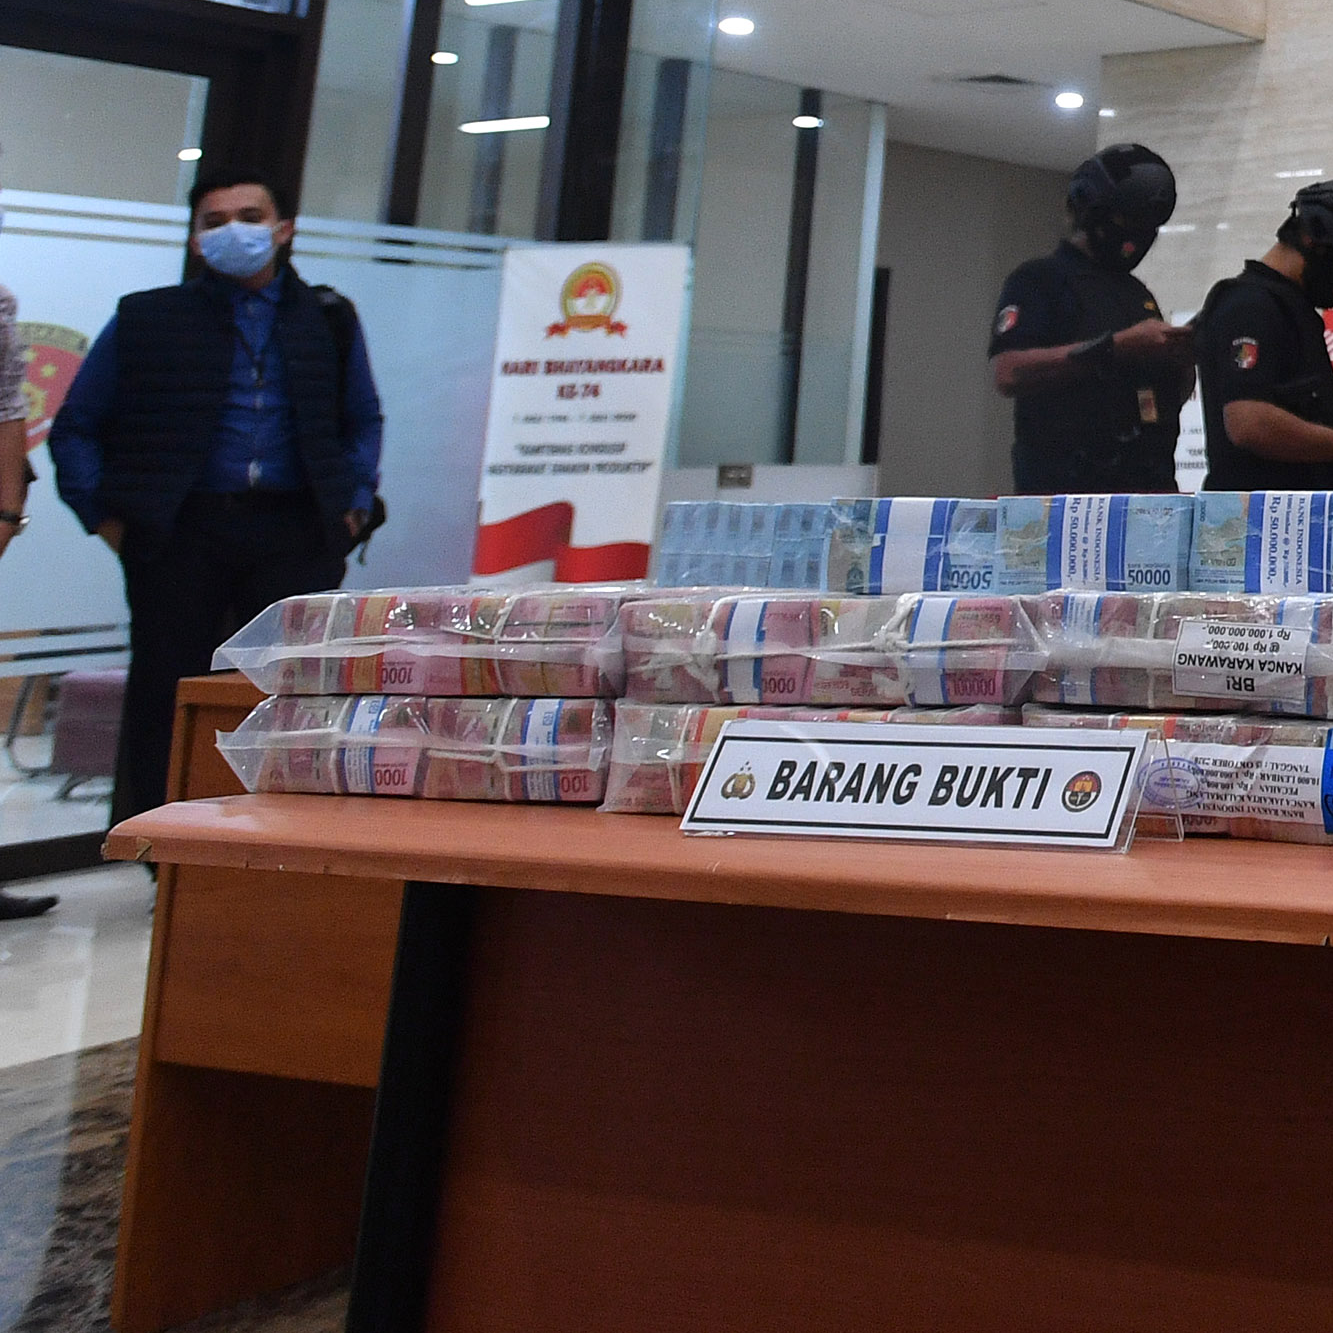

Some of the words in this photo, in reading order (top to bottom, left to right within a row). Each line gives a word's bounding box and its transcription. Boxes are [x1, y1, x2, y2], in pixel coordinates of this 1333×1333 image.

[1070, 497, 1081, 513] Rp
[1269, 496, 1281, 513] Rp
[1297, 497, 1306, 526] BANK
[1067, 516, 1080, 582] 50.000.000,-
[1094, 527, 1103, 581] INDONESIA
[1266, 516, 1279, 585] 50.000.000,-
[1295, 528, 1304, 585] INDONESIA
[1127, 568, 1171, 587] 50000
[1202, 625, 1274, 639] 1.000.000.000,-
[1276, 628, 1291, 641] Rp
[1253, 643, 1268, 654] Rp
[1177, 653, 1255, 671] KARAWANG
[1258, 660, 1303, 675] KANCA
[1211, 757, 1254, 769] OKTOBER
[1270, 761, 1310, 773] TANGGAL
[765, 759, 923, 805] BARANG
[927, 764, 1053, 810] BUKTI
[1260, 772, 1296, 784] LEMBAR
[1186, 790, 1246, 804] KALIMALANG
[1246, 795, 1285, 806] JAKARTA
[1285, 798, 1316, 809] KANCA
[1196, 801, 1244, 814] INDONESIA
[1244, 805, 1280, 817] RAKYAT
[1280, 809, 1305, 819] BANK
